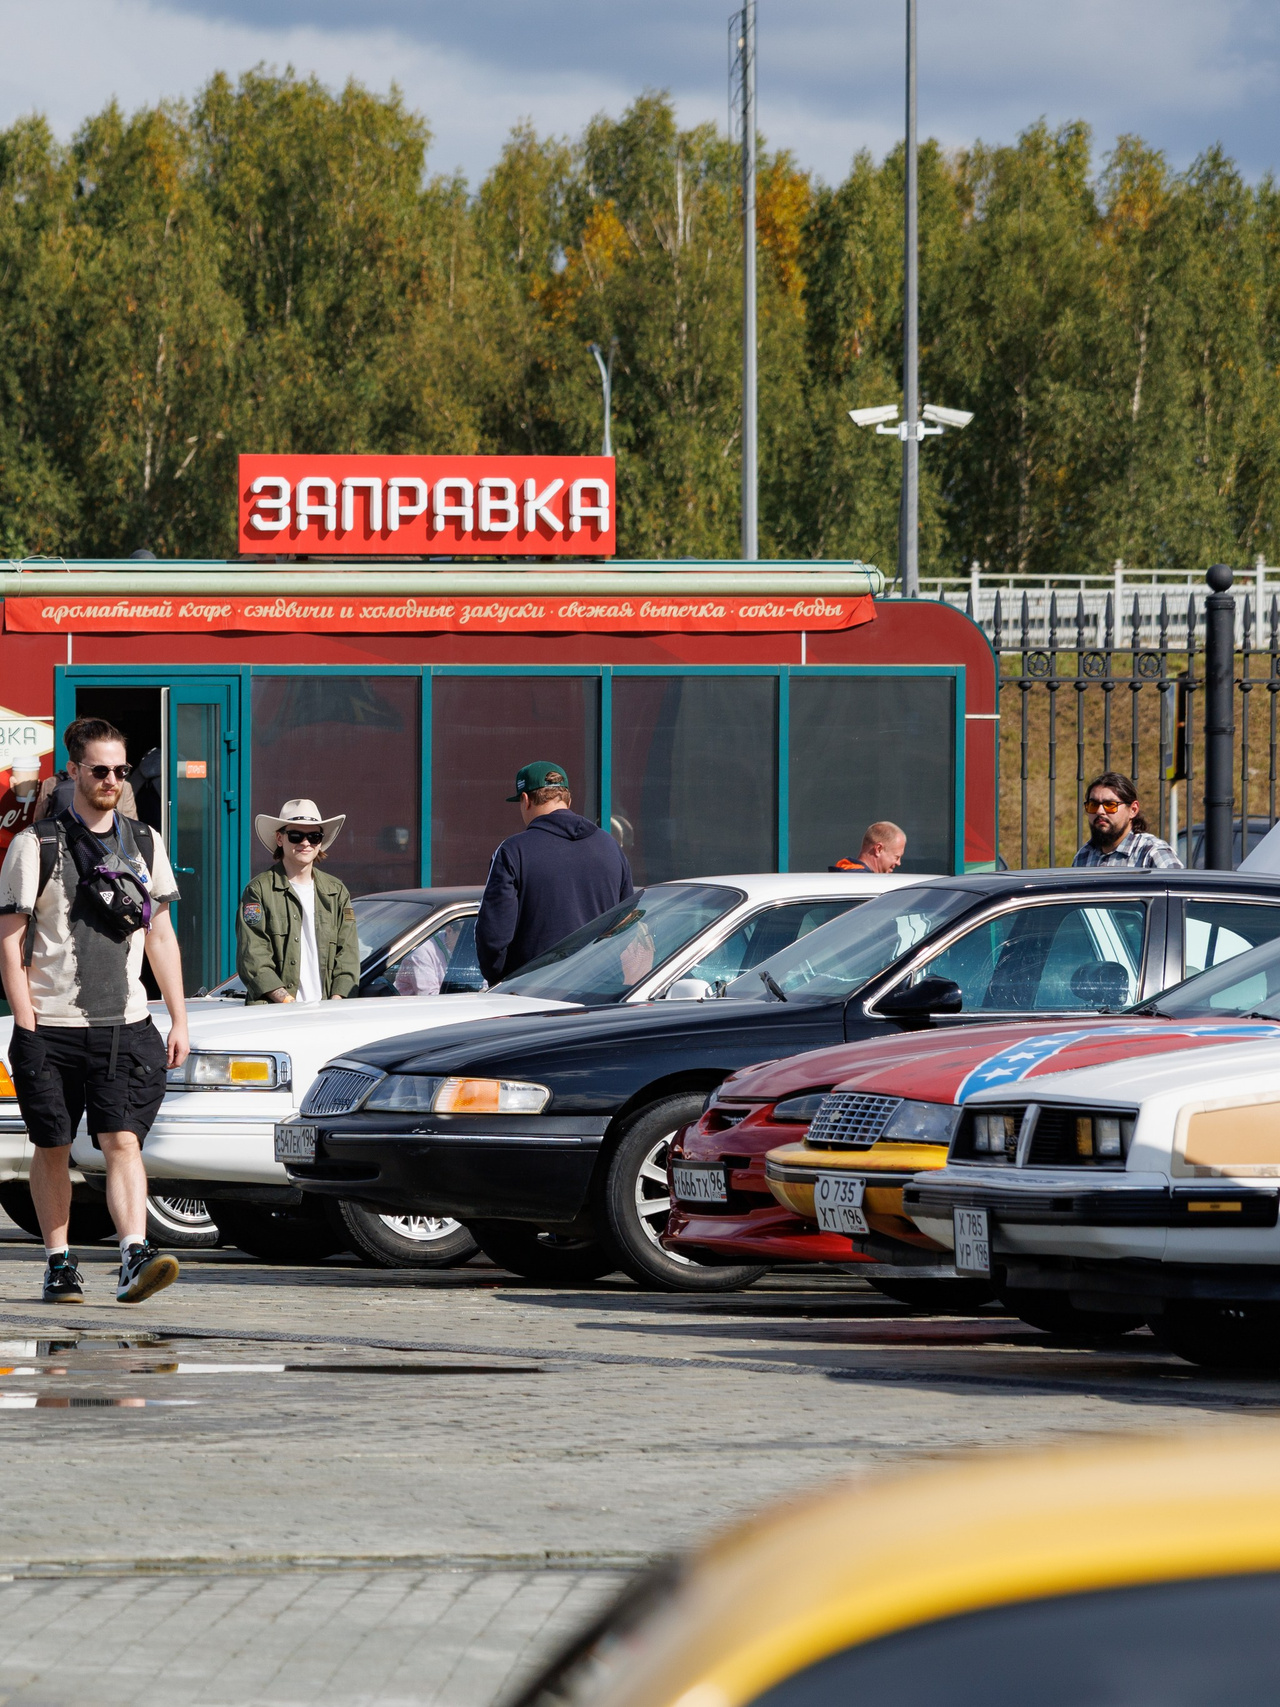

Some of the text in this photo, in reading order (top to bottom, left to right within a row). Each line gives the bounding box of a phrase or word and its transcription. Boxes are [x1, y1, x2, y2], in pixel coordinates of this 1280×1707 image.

[250, 476, 610, 532] ЗАПРАВКА
[41, 598, 844, 625] ароматный кофе сэндвичи и холодные закуски свежая выпечка соки-воды
[301, 1128, 314, 1148] 196
[677, 1171, 723, 1198] Х666ТХ 96
[834, 1180, 856, 1203] 735
[819, 1207, 862, 1229] ХТ 196
[966, 1213, 983, 1237] 785
[959, 1243, 988, 1267] УР 196
